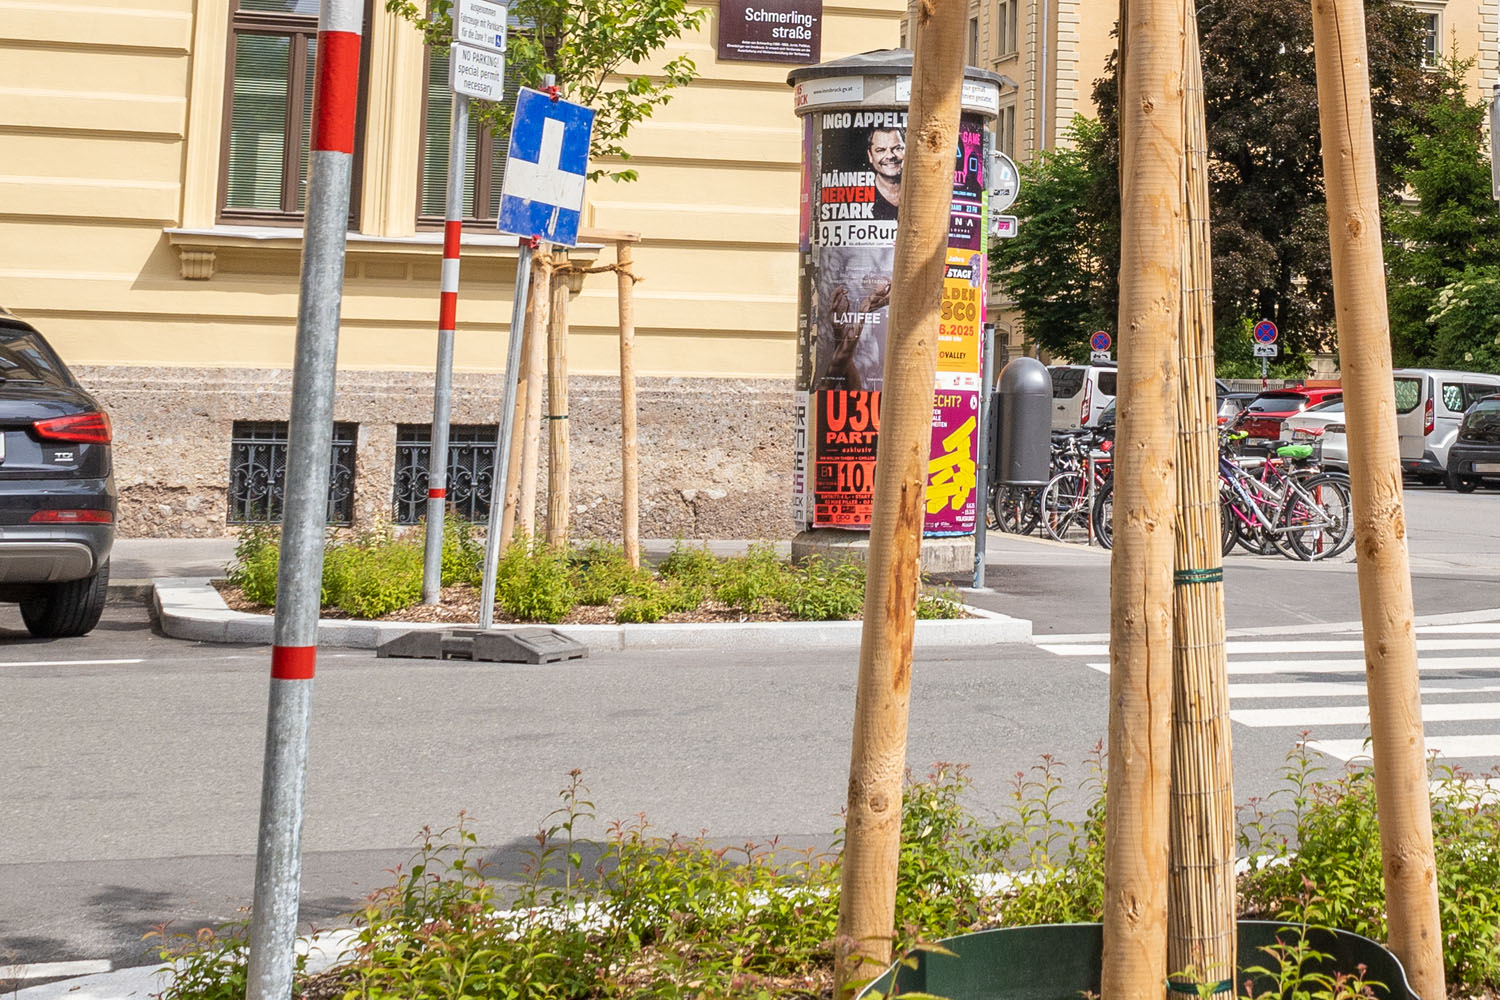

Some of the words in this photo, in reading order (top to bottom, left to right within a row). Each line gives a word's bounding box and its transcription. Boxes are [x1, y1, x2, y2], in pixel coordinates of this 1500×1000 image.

[745, 7, 818, 28] Schmerling-
[772, 26, 812, 40] straße
[462, 49, 471, 62] NO
[472, 52, 500, 68] PARKING!
[458, 63, 479, 78] special
[480, 69, 500, 82] permit
[464, 80, 493, 96] necessary
[823, 112, 851, 129] INGO
[853, 112, 908, 128] APPELT
[963, 131, 981, 146] GAME
[821, 169, 876, 187] MÄNNER
[953, 171, 967, 183] RTY
[821, 186, 876, 203] NERVEN
[821, 202, 875, 220] STARK
[822, 225, 846, 247] 9.5.
[943, 287, 975, 301] LDEN
[941, 301, 976, 321] SCO
[939, 323, 974, 336] 6.2025
[939, 351, 966, 359] OVALLEY
[933, 395, 962, 408] ECHT?
[826, 431, 879, 444] PART
[841, 463, 876, 492] 10.
